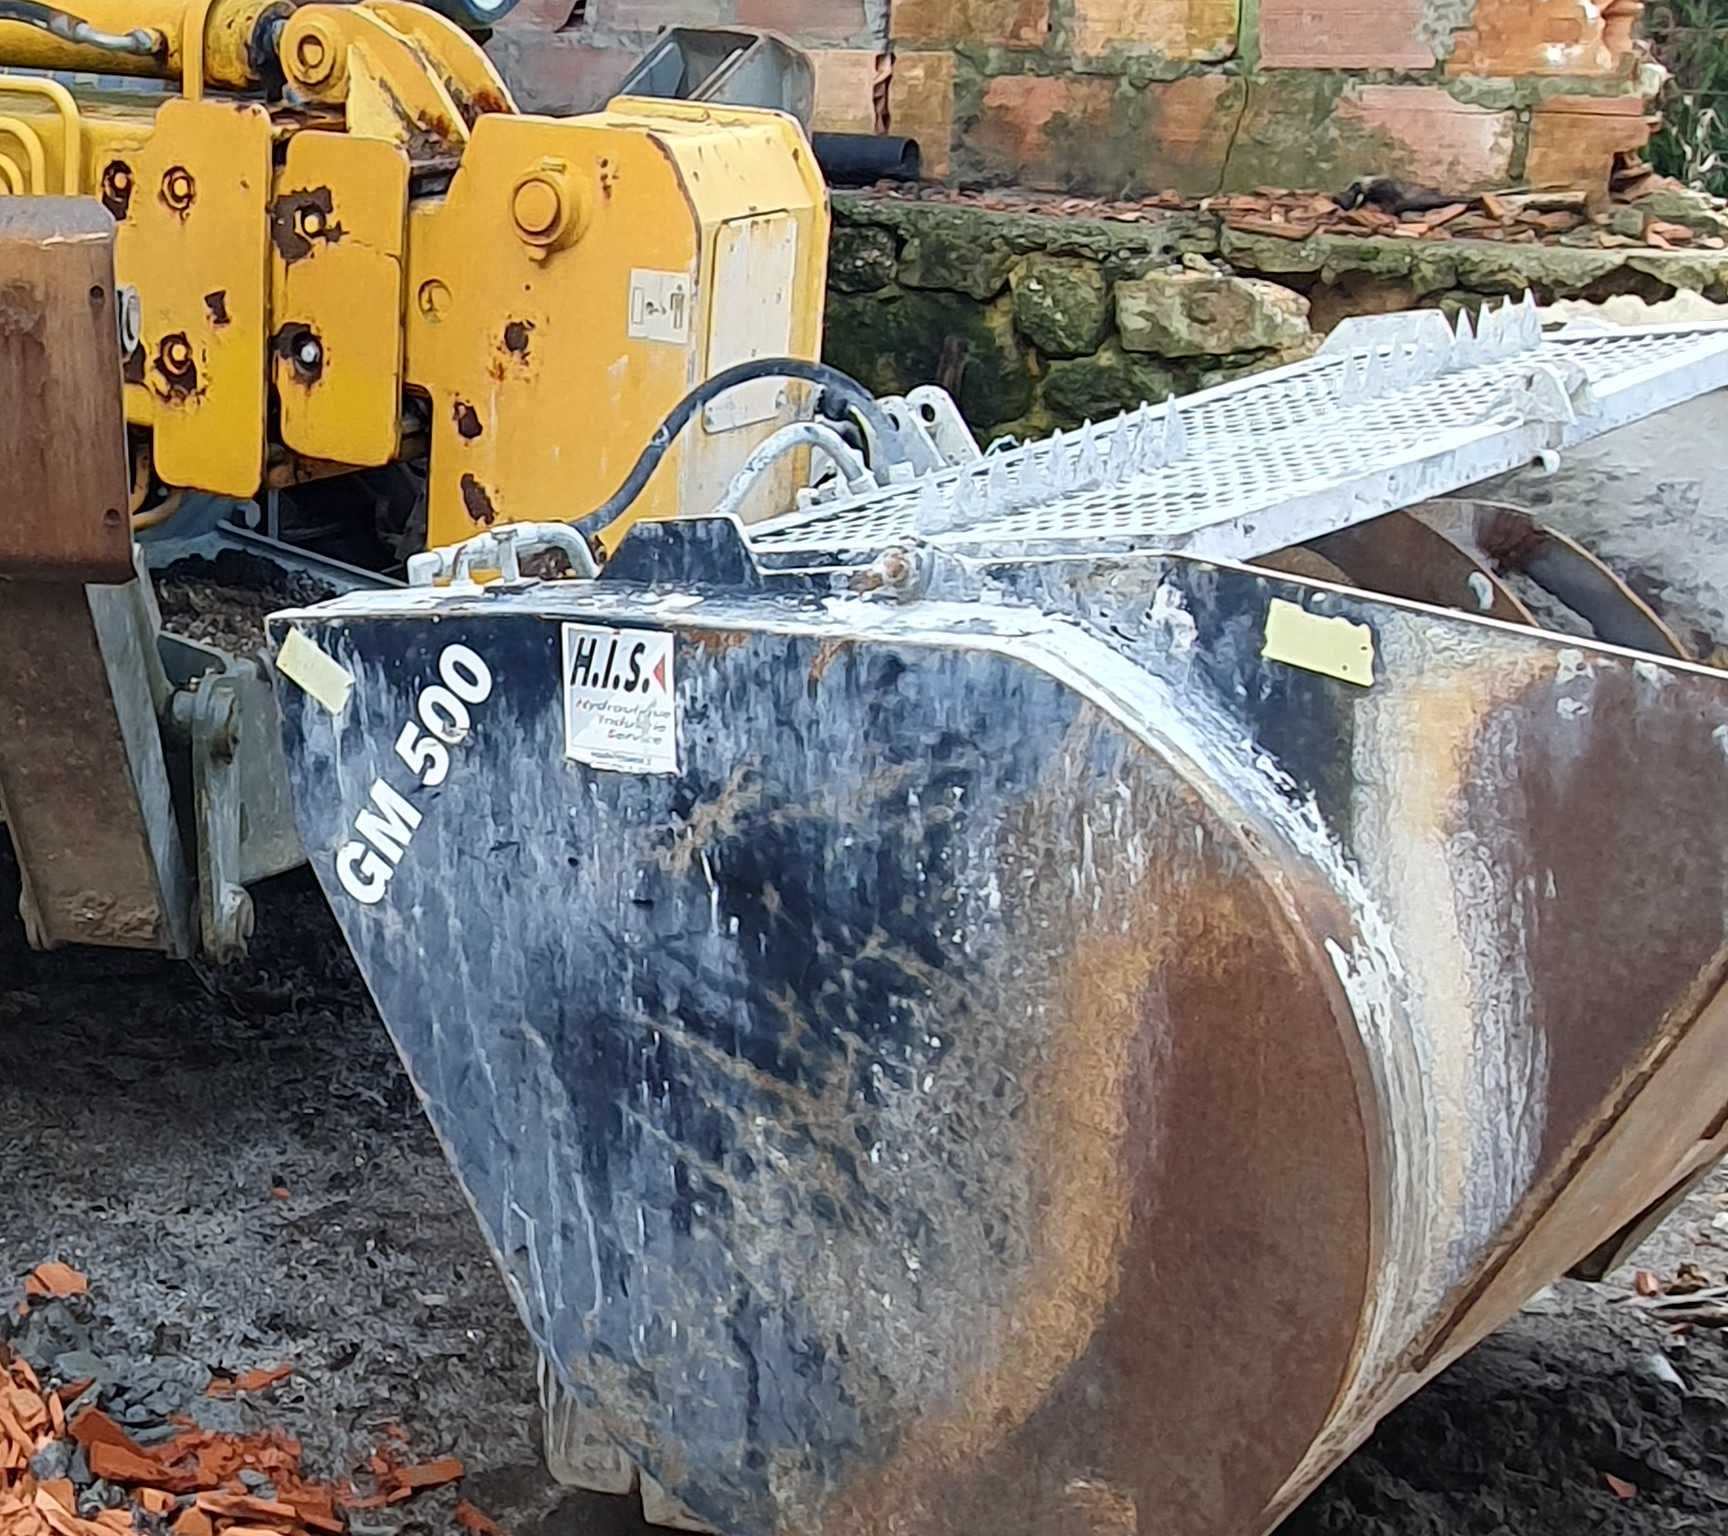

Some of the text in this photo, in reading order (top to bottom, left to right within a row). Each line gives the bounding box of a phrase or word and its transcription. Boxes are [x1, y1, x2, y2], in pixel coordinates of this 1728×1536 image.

[570, 636, 650, 694] H.I.S.
[336, 643, 492, 905] GM 500
